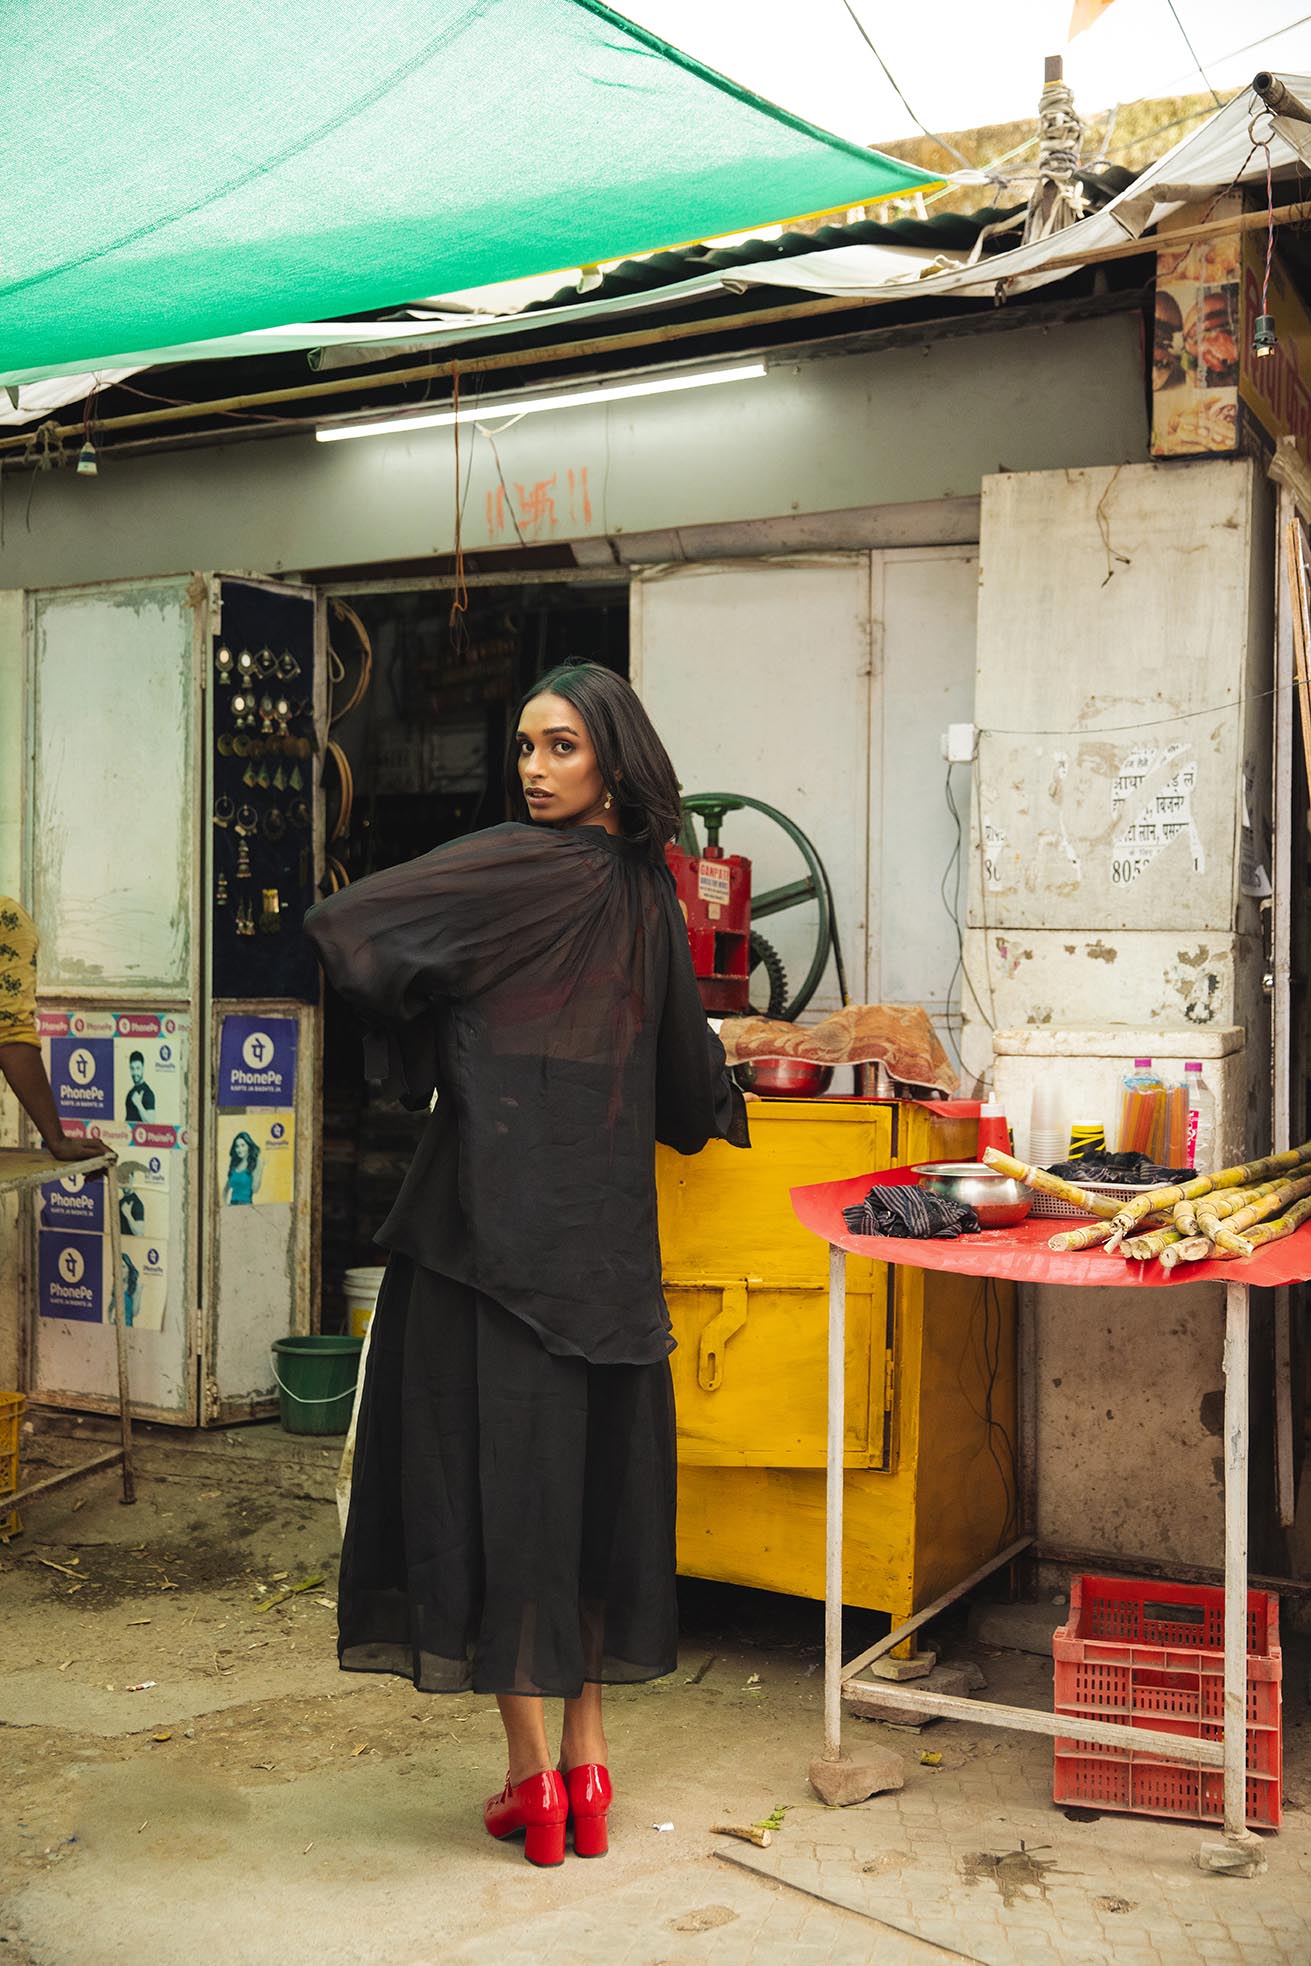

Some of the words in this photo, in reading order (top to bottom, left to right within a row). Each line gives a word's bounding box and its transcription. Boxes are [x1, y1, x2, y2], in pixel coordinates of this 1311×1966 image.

[231, 1069, 282, 1085] PhonePe
[60, 1085, 104, 1101] PhonePe
[51, 1192, 94, 1209] PhonePe
[50, 1282, 93, 1300] PhonePe
